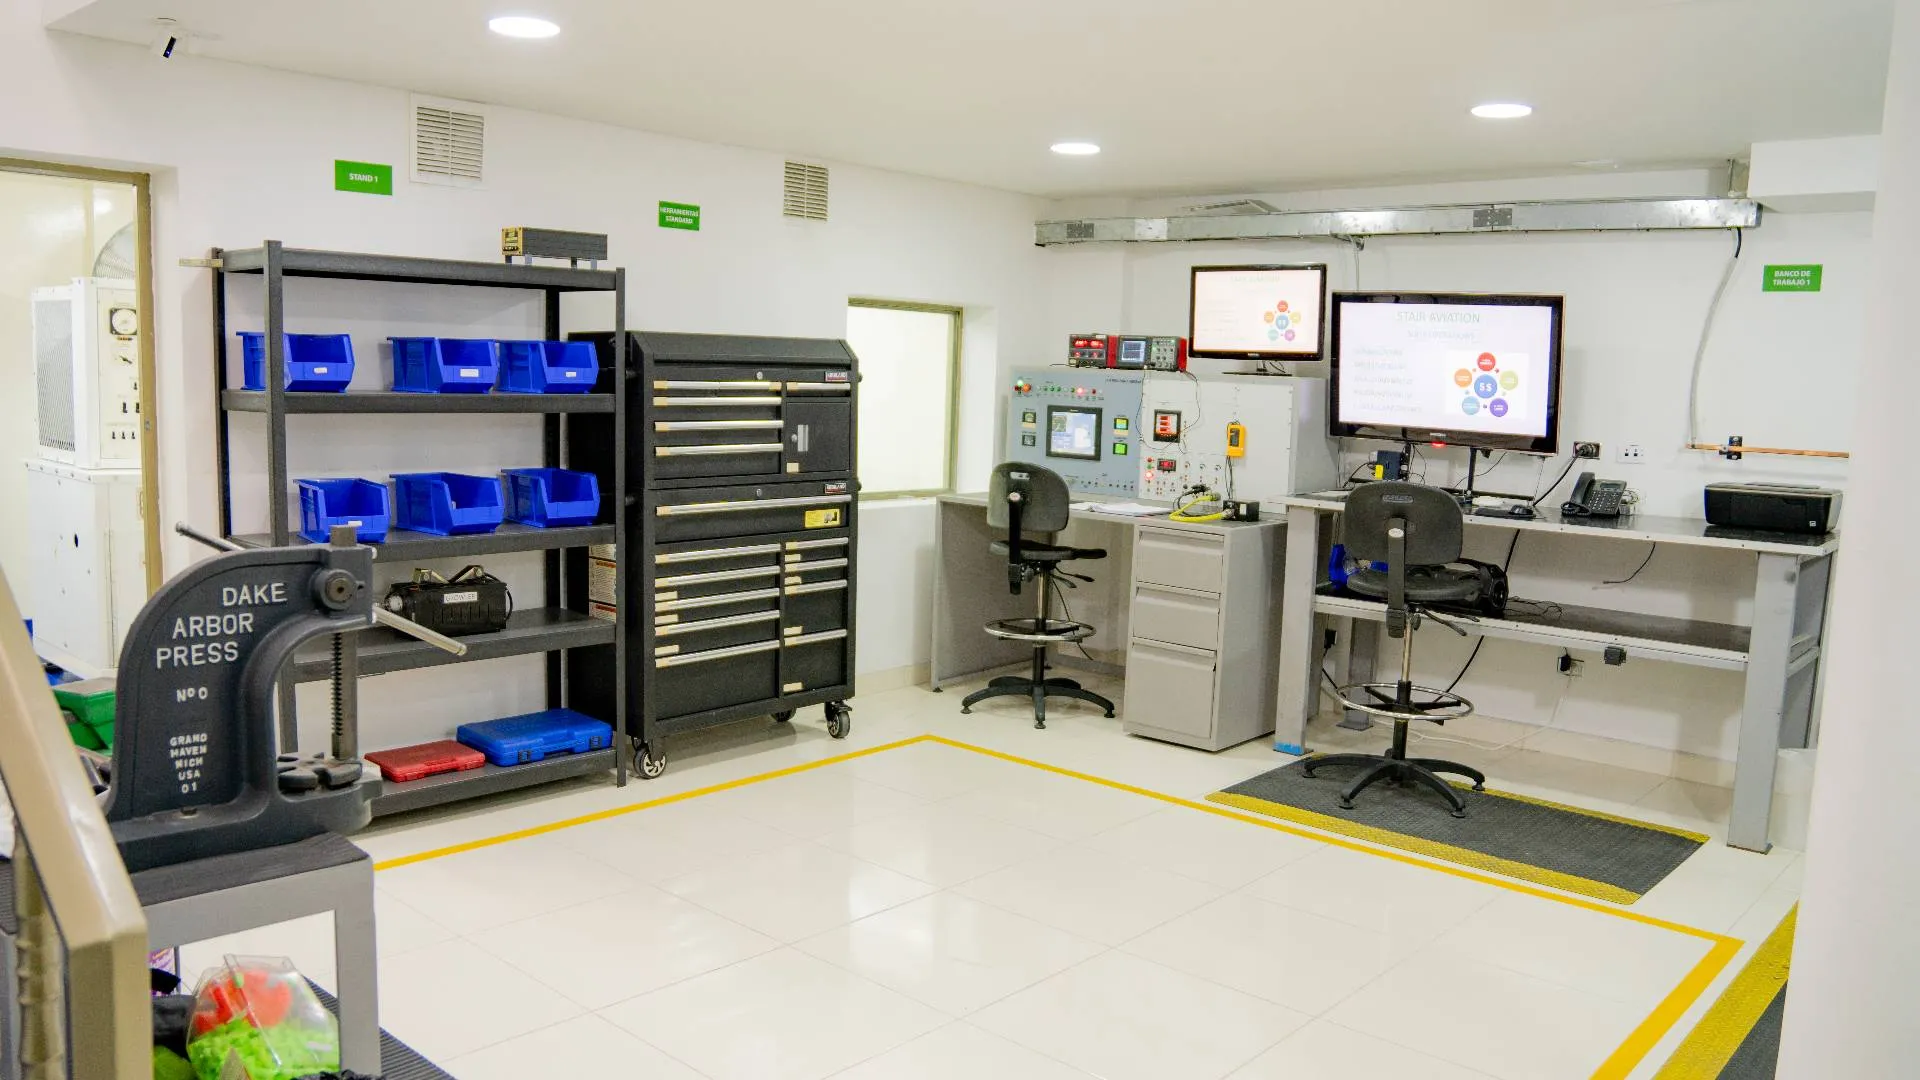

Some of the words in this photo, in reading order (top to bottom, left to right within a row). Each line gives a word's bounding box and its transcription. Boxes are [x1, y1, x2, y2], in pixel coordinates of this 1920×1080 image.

[349, 173, 373, 183] STAND
[1396, 310, 1427, 323] STAIR
[1429, 310, 1480, 324] AVIATION
[222, 582, 288, 607] DAKE
[172, 612, 254, 640] ARBOR
[156, 641, 239, 669] PRESS
[169, 733, 208, 746] GRAND
[169, 745, 208, 759] HAVEN
[174, 757, 204, 769] MICH
[178, 770, 201, 781] USA
